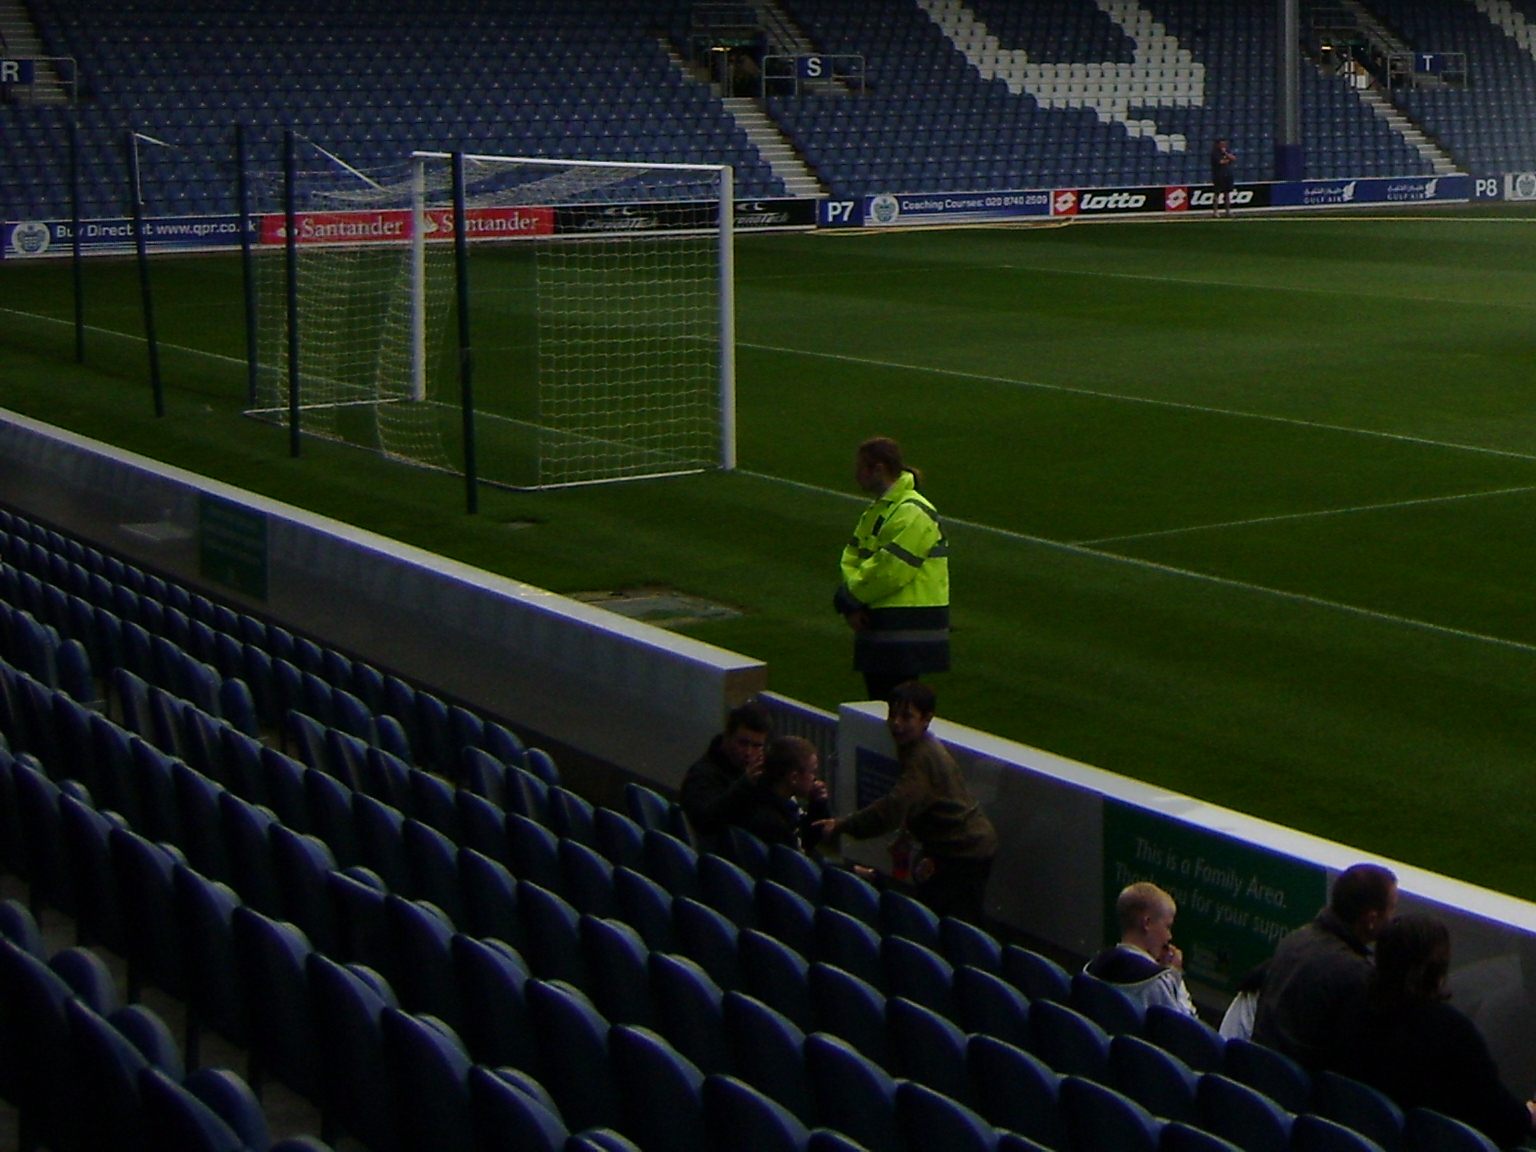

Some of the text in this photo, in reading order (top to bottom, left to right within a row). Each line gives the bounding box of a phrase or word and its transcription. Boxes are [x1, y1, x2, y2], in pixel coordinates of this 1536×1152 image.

[1, 60, 20, 83] R
[806, 56, 822, 78] S
[1422, 54, 1434, 72] T
[1475, 178, 1498, 197] P8
[827, 200, 855, 223] P7
[902, 199, 945, 211] Coaching
[87, 223, 134, 237] Direct
[156, 219, 256, 236] www.qpr.co.k
[302, 211, 540, 238] Santander Sntander
[1136, 836, 1288, 909] This is a Family Area.
[1191, 888, 1213, 916] for
[1214, 901, 1251, 928] your
[1253, 915, 1290, 944] supp
